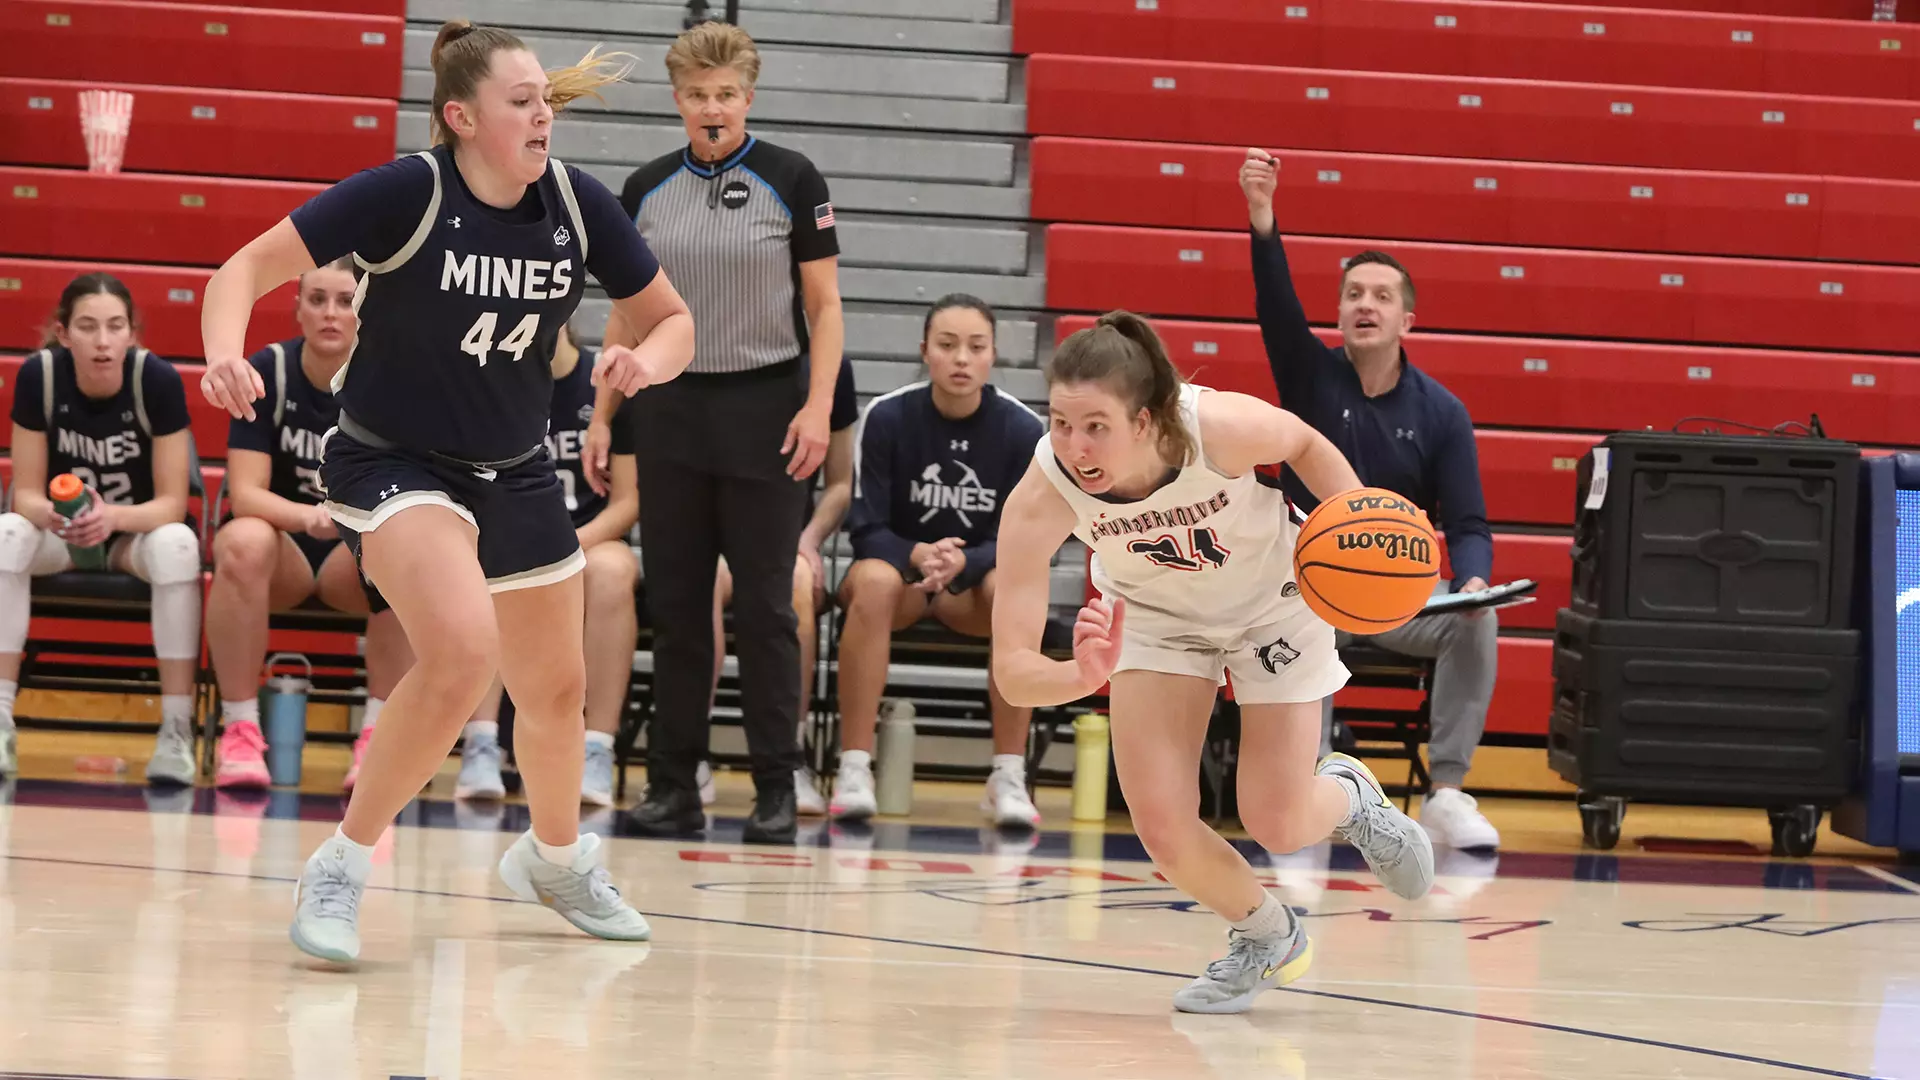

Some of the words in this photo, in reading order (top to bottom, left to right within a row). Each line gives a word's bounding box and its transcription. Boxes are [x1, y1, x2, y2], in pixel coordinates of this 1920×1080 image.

[440, 249, 572, 300] MINES
[460, 311, 541, 368] 44
[57, 427, 141, 466] MINES
[909, 479, 997, 513] MINES
[1347, 496, 1416, 517] NCAA
[1336, 532, 1431, 565] Wilson
